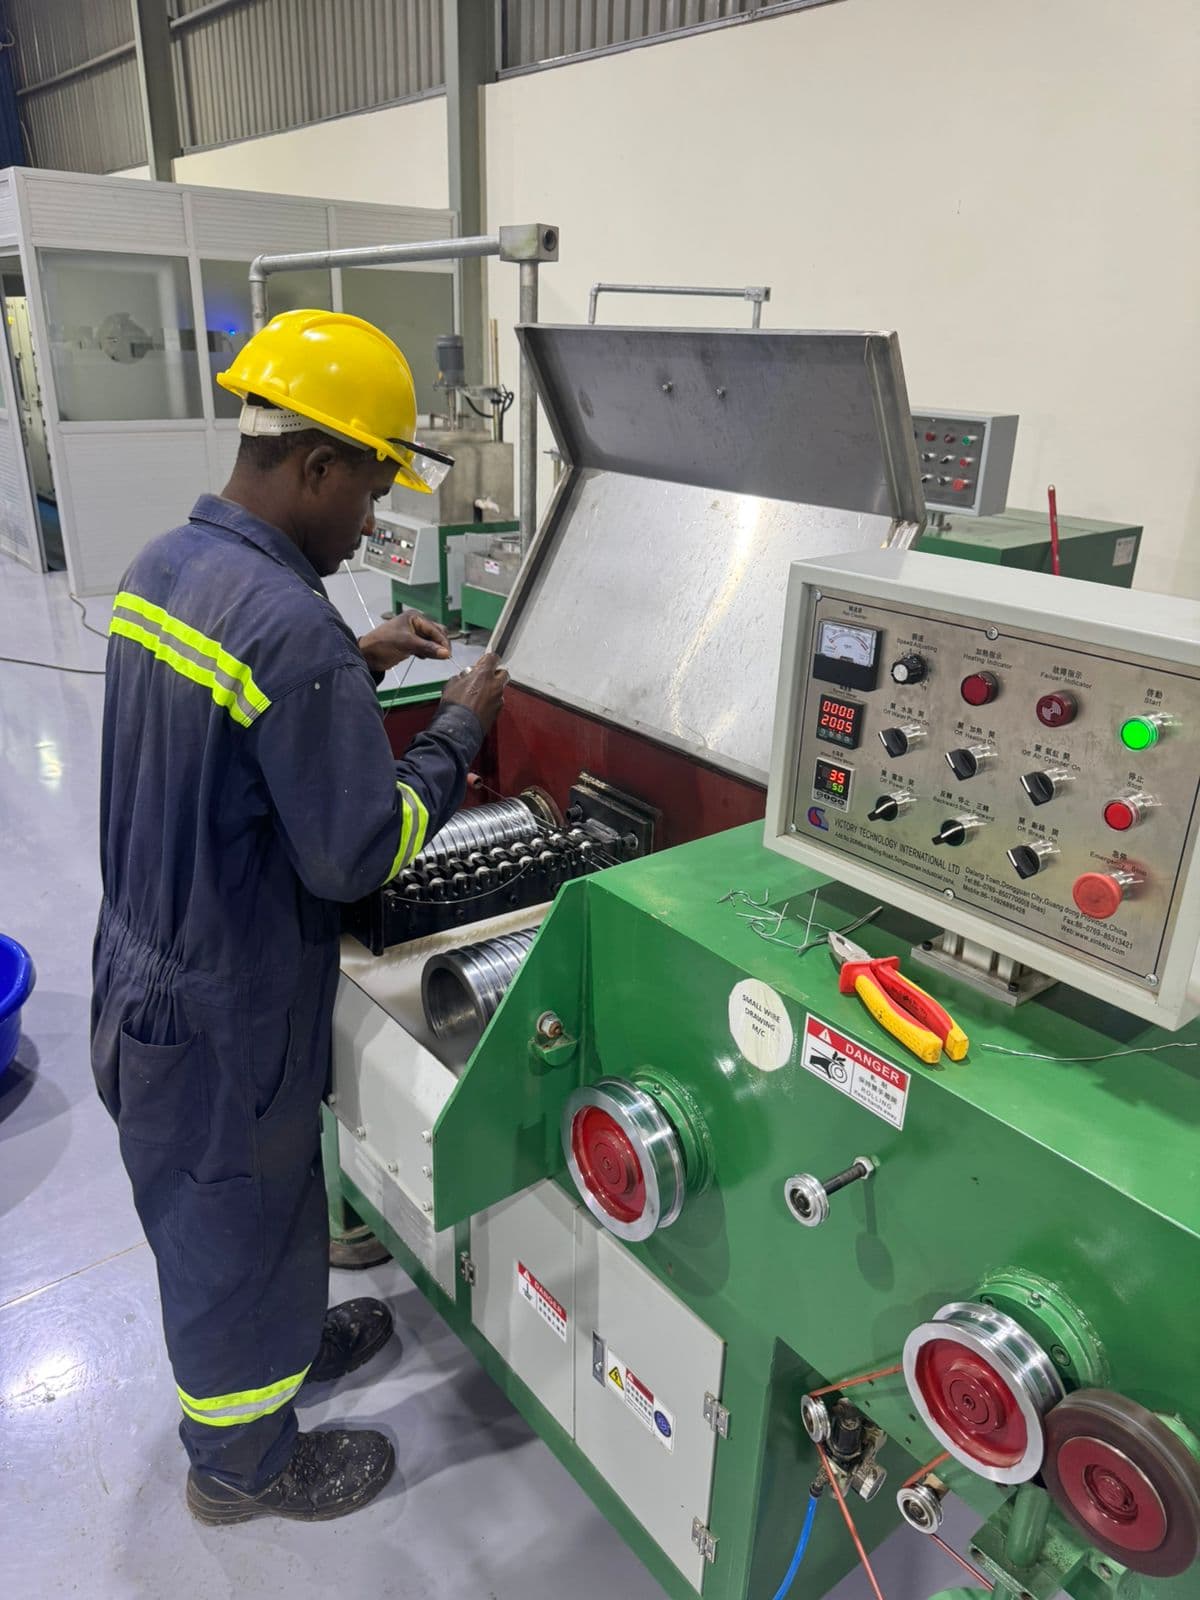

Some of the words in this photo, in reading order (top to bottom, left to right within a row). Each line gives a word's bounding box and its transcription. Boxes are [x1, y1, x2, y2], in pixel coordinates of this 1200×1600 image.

[897, 638, 913, 647] Speed
[913, 641, 938, 653] Adjusting
[963, 653, 985, 664] Heating
[987, 659, 1013, 670] Indicator
[1064, 678, 1092, 689] Indicator
[1144, 697, 1162, 707] Start
[822, 701, 855, 720] 0000
[820, 714, 853, 734] 2005
[965, 733, 987, 745] Heating
[1032, 751, 1042, 759] Air
[1043, 755, 1070, 768] Cylinder
[1071, 763, 1081, 771] On
[829, 769, 845, 784] 35
[890, 779, 905, 789] Power
[1128, 772, 1144, 784] 停止
[831, 782, 844, 793] 50
[1127, 781, 1143, 791] Stop
[932, 796, 959, 809] Backward
[972, 808, 995, 821] Forward
[1017, 825, 1026, 833] Off
[1028, 829, 1046, 840] Break
[834, 818, 858, 833] VICTORY
[859, 827, 898, 850] TECHNOLOGY
[899, 844, 947, 871] INTERNATIONAL
[947, 860, 960, 875] LTD
[742, 994, 763, 1013] SMALL
[763, 1007, 781, 1024] WIRE
[744, 1007, 776, 1032] DRAWING
[752, 1023, 766, 1037] M/C
[845, 1042, 901, 1084] DANGER
[854, 1090, 867, 1101] Keep
[867, 1098, 883, 1111] hands
[883, 1109, 897, 1121] away
[861, 1087, 892, 1110] ROLLING
